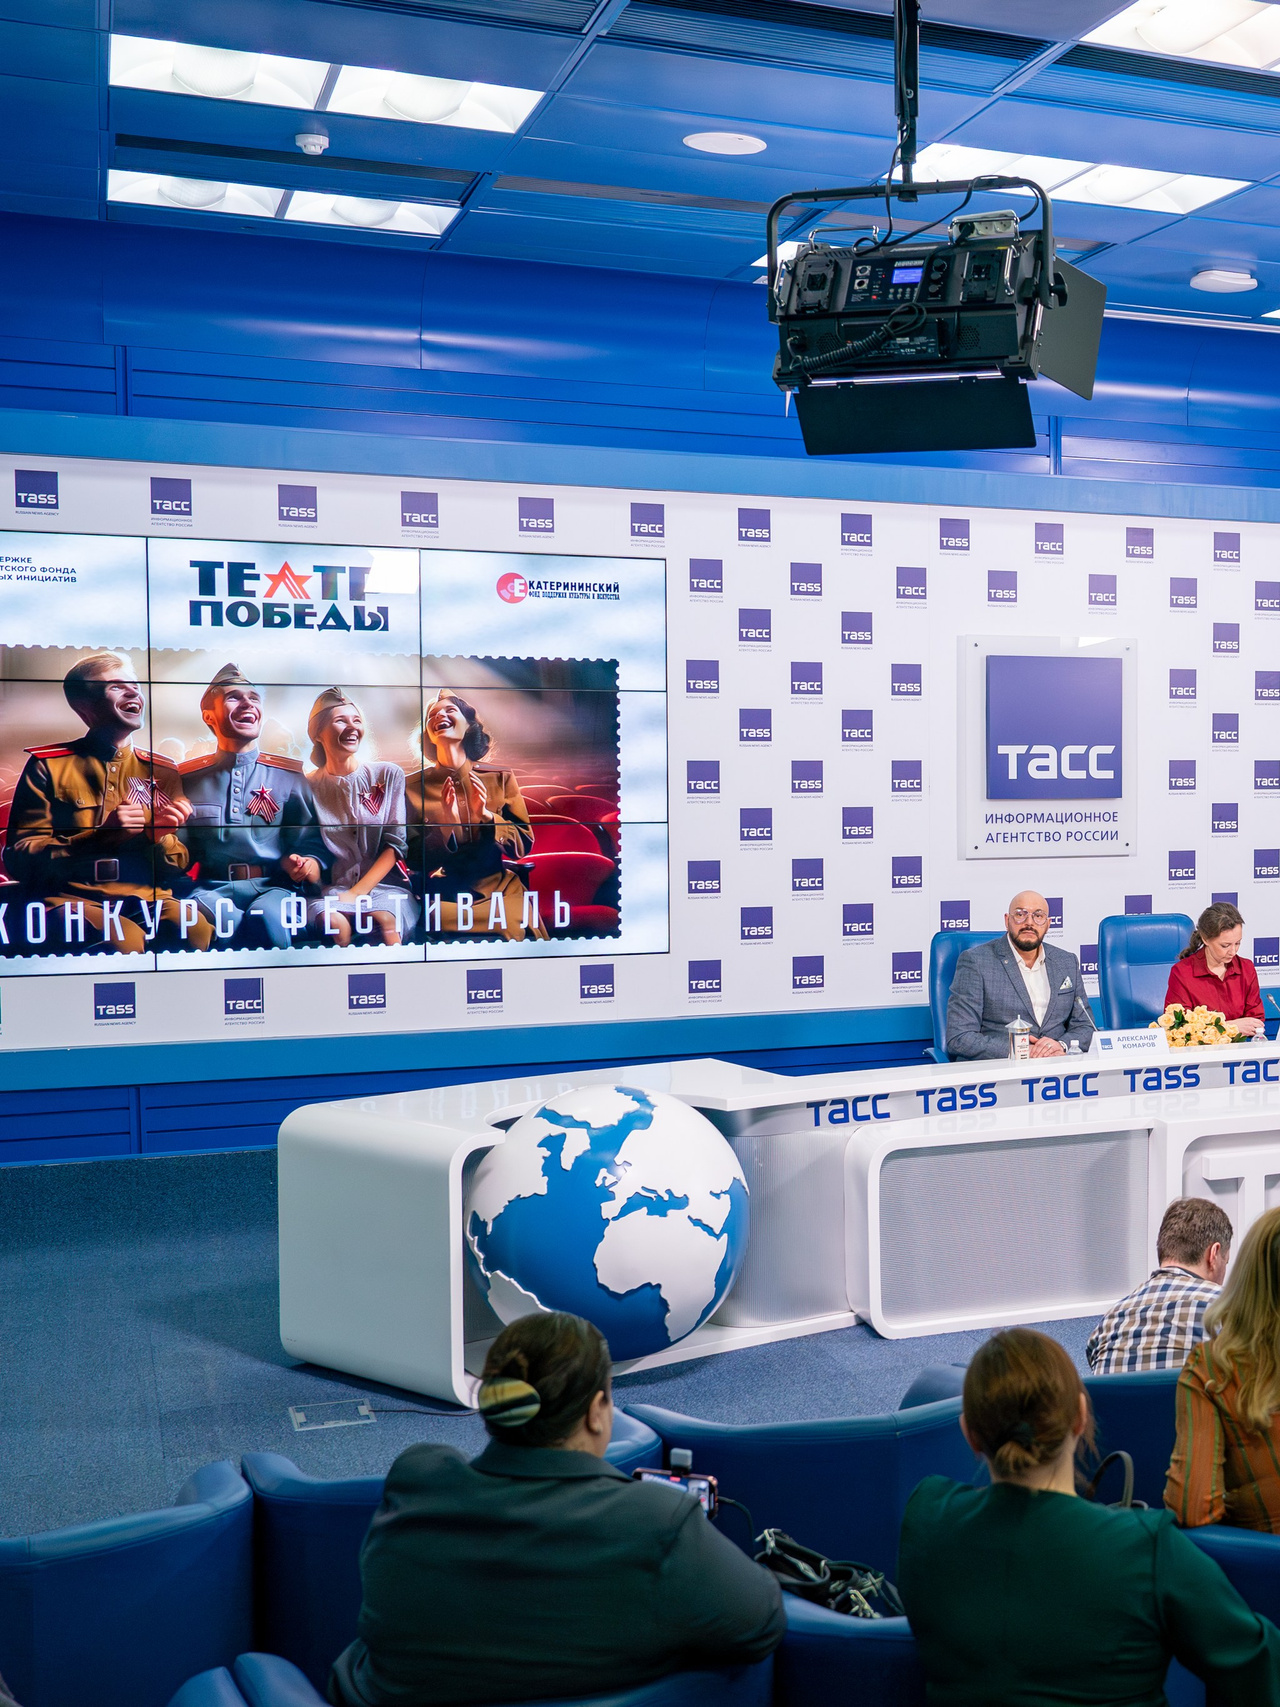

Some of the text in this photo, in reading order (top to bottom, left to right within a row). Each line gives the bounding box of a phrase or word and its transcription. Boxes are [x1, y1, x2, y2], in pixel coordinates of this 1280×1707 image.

[16, 574, 77, 583] ИНИЦИАТИВ
[189, 600, 389, 633] ПОБЕДЫ
[985, 811, 1118, 825] ИНФОРМАЦИОННОЕ
[985, 830, 1119, 843] АГЕНТСТВО РОССИИ
[1117, 1034, 1158, 1043] АЛЕКСАНДР
[1122, 1041, 1156, 1049] КОМАРОВ
